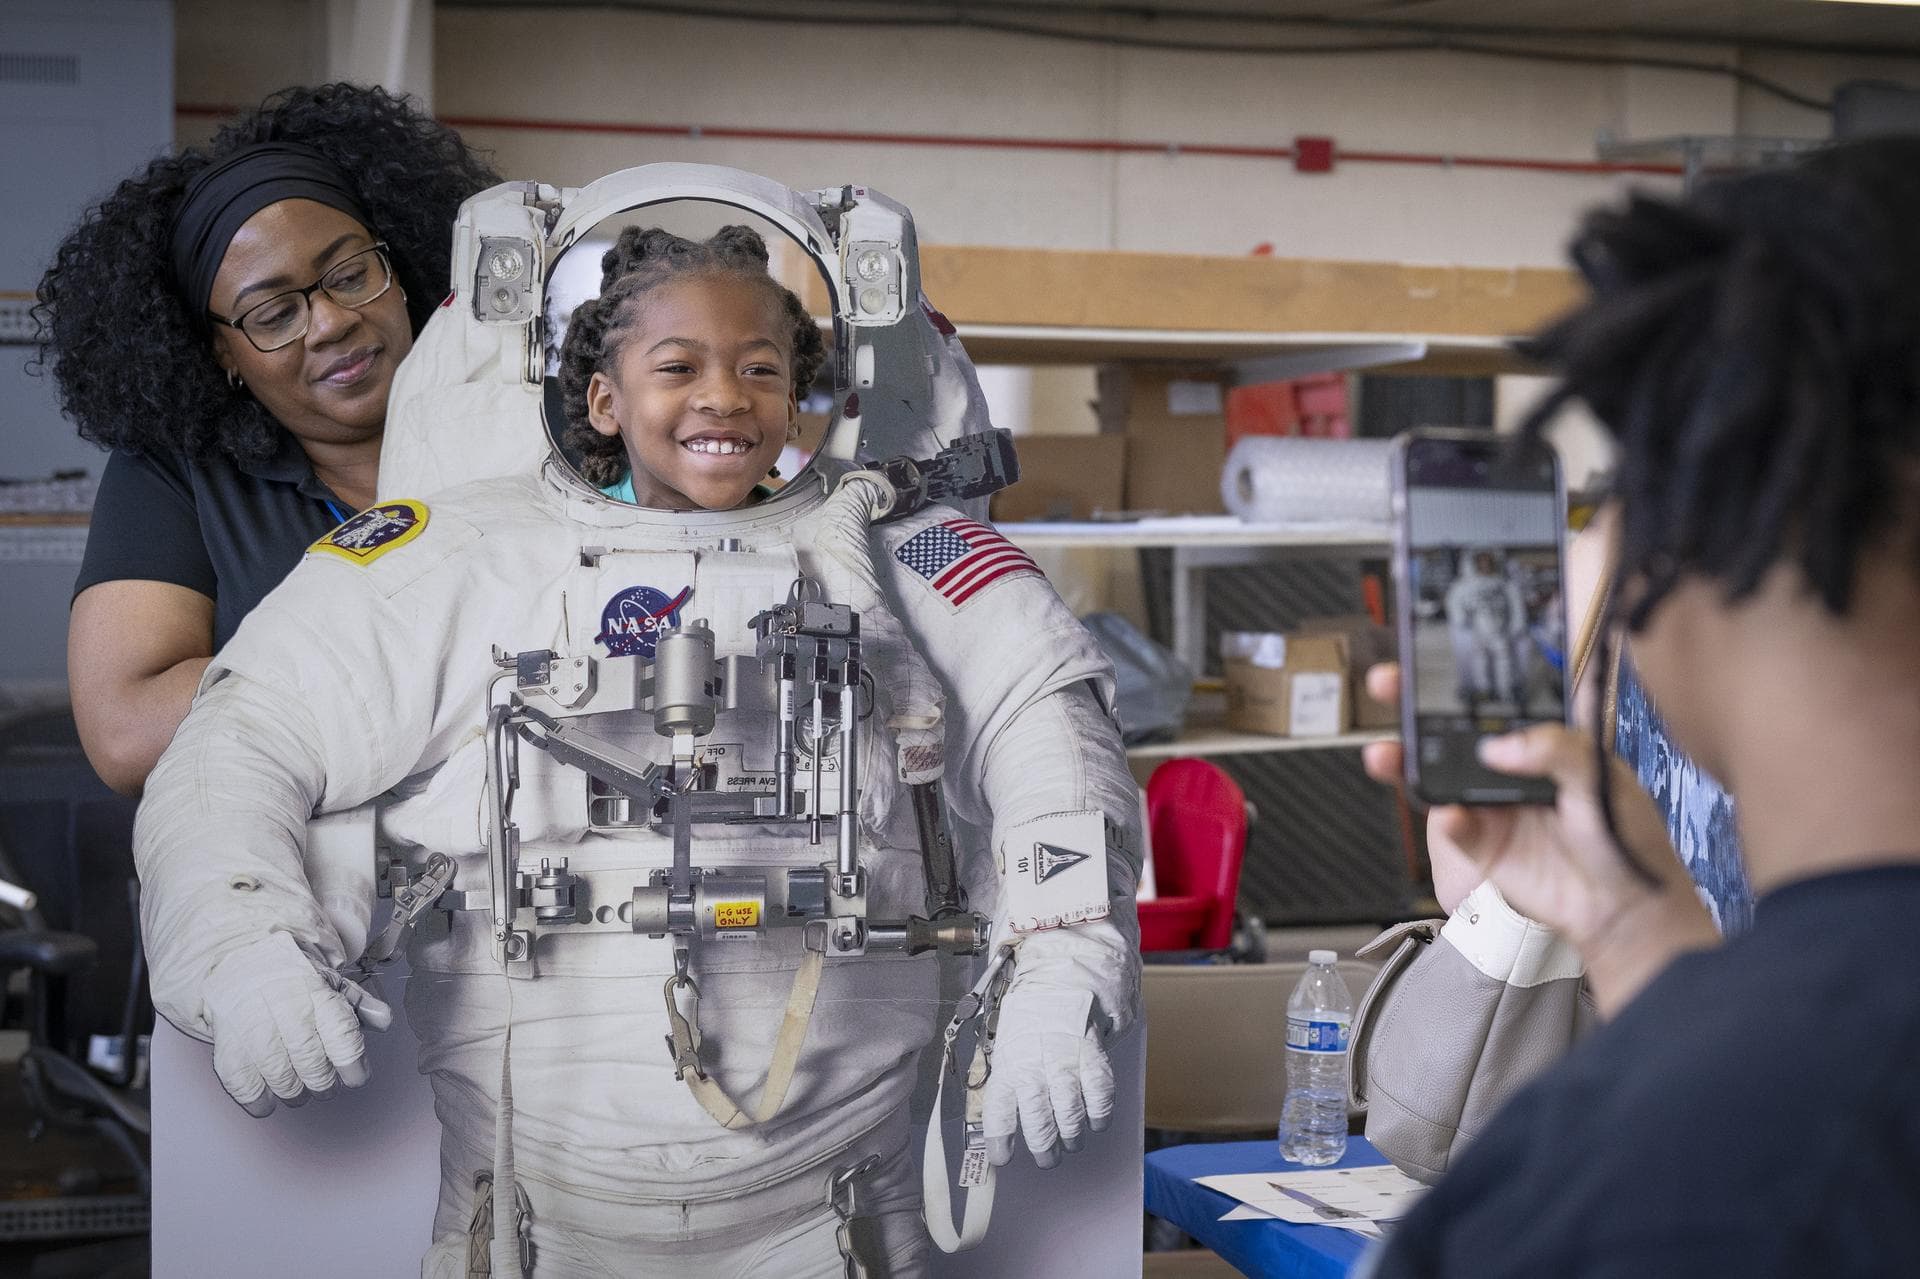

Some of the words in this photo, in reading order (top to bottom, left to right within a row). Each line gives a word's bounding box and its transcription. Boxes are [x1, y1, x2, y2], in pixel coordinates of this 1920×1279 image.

[608, 616, 671, 635] NASA
[1018, 857, 1029, 873] 101
[736, 907, 753, 915] USE
[720, 916, 750, 925] ONLY
